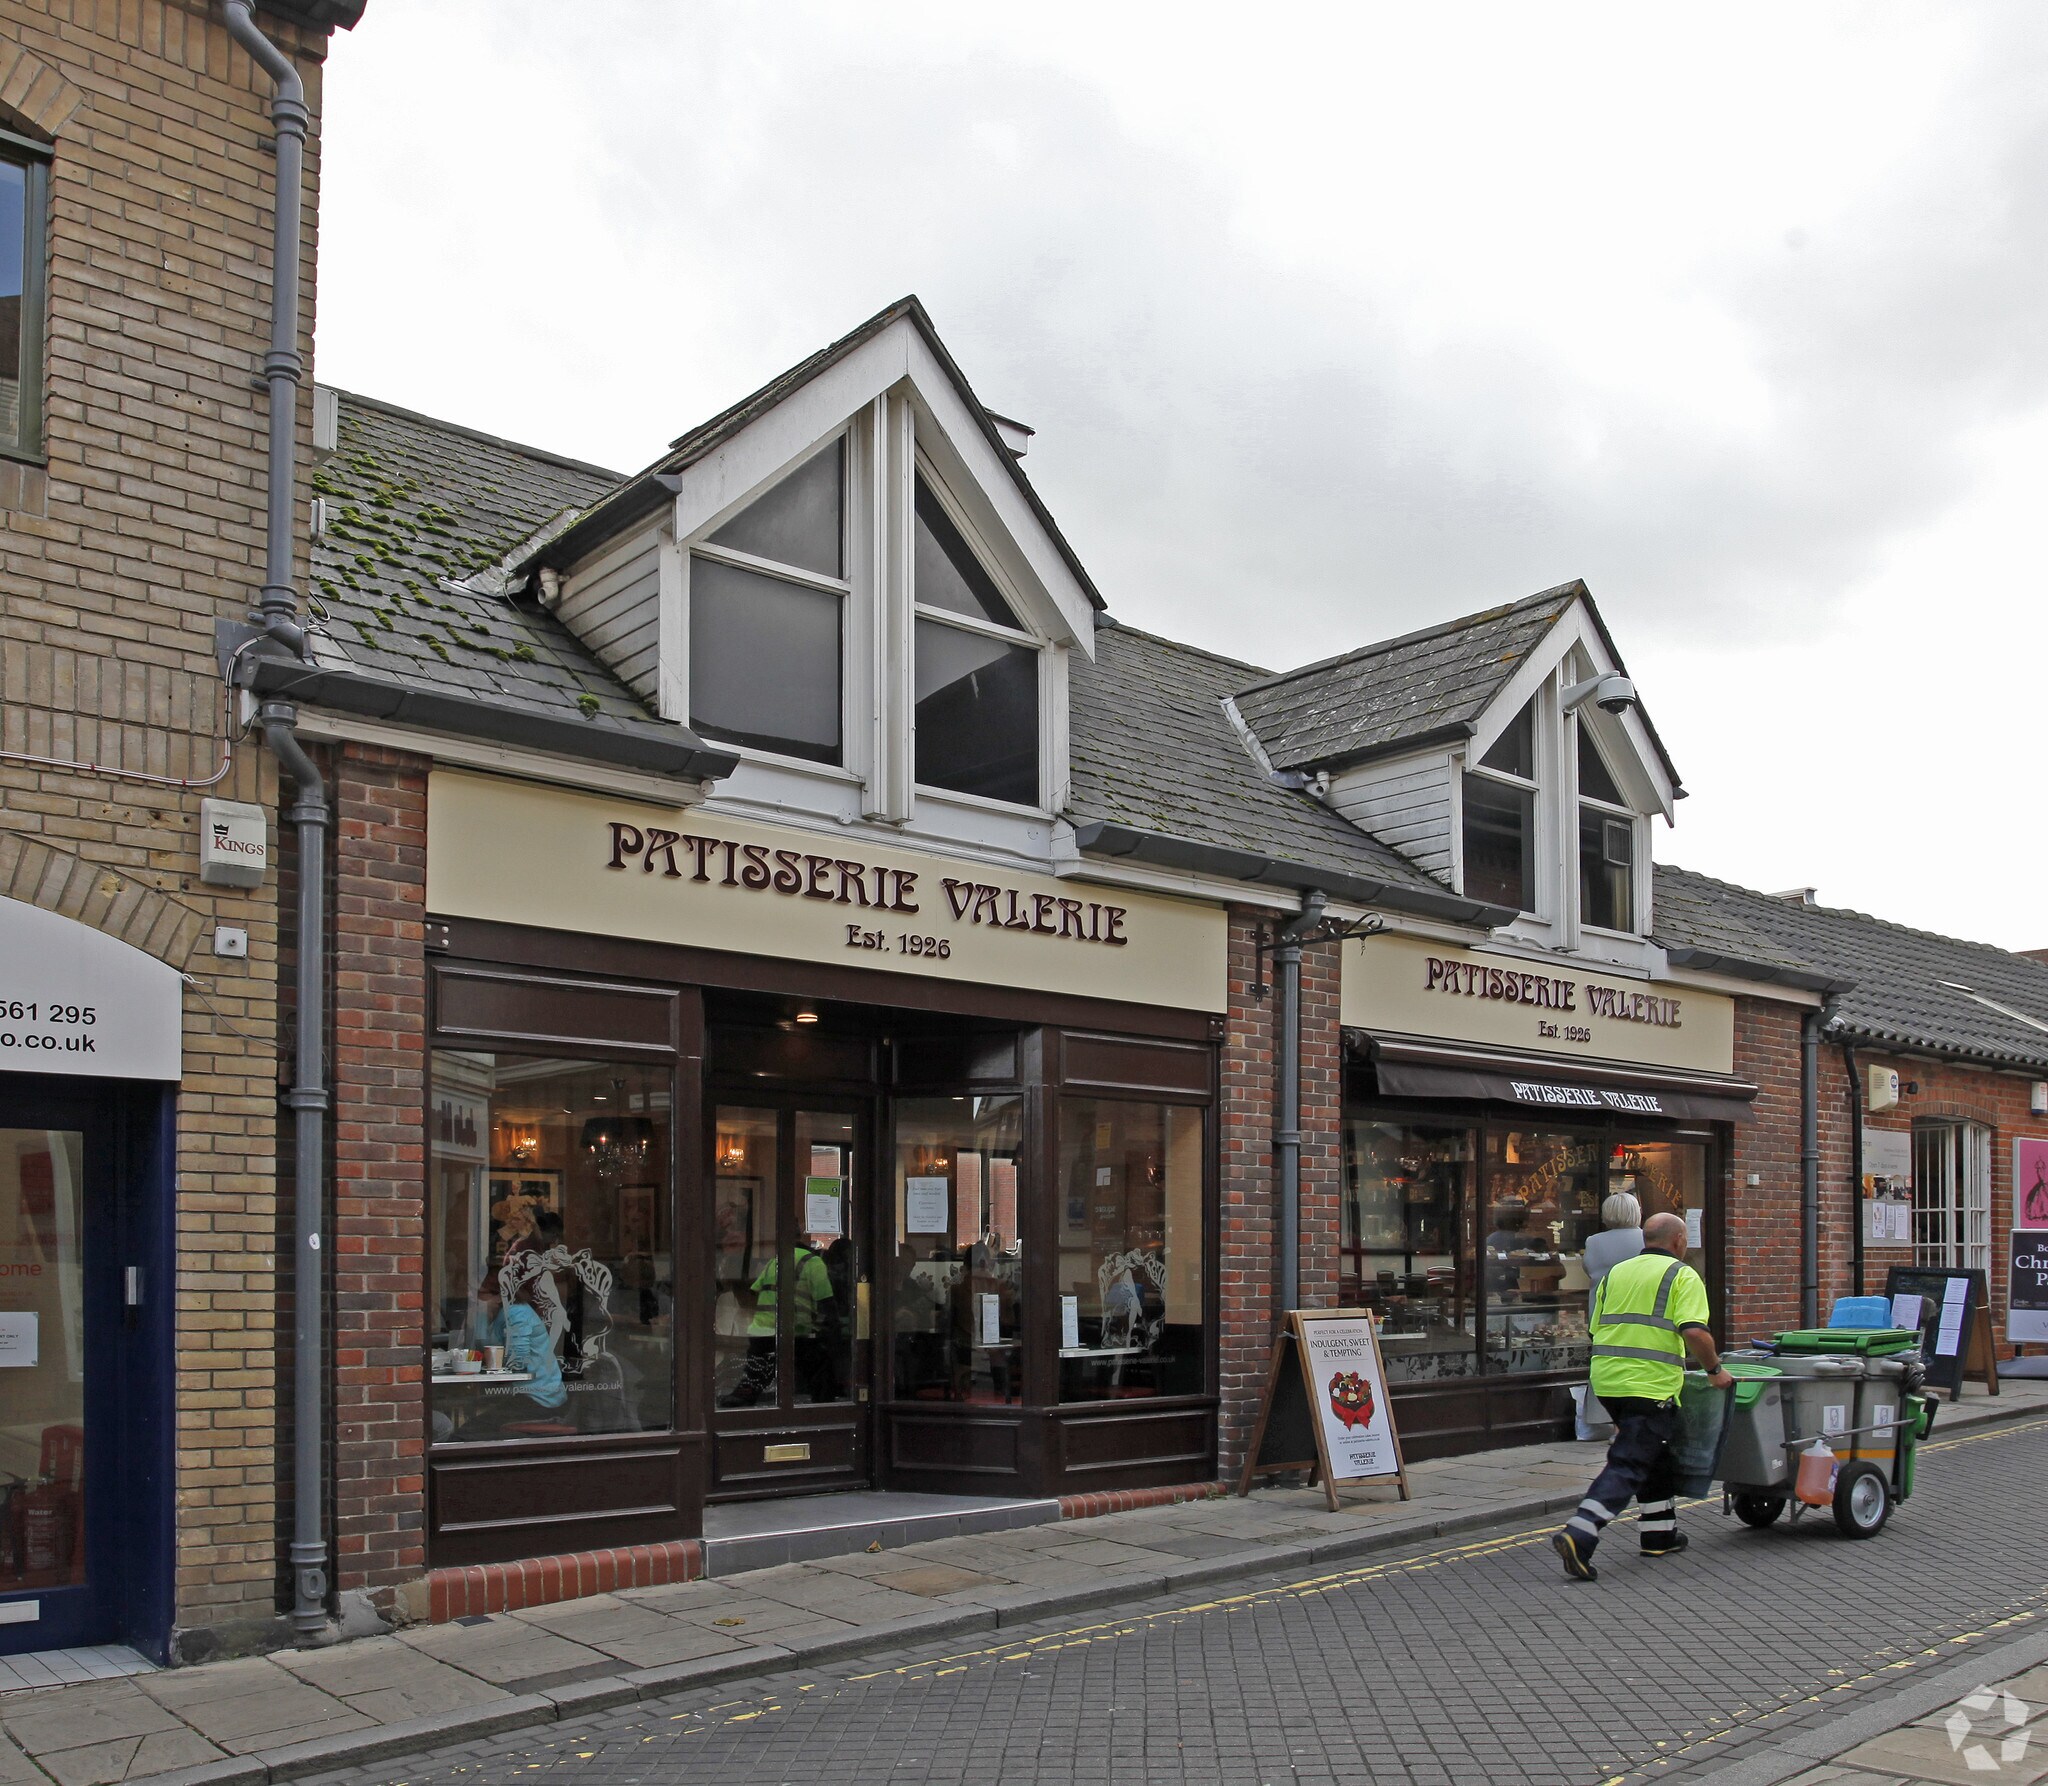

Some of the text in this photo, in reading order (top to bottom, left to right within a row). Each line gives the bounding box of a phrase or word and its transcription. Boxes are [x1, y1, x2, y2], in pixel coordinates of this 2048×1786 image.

[214, 835, 264, 855] KINGS
[607, 822, 1128, 946] PATISSERIE VALERIE
[846, 924, 951, 959] Est. 1926
[1424, 957, 1682, 1028] PATISSERIE VALERIE
[49, 1005, 96, 1025] 295
[1538, 1021, 1591, 1043] Est. 1926
[1510, 1081, 1662, 1112] PATISSERIE VALERIE
[1310, 1338, 1370, 1348] INDULGENT, SWEET
[1324, 1349, 1362, 1358] & TEMPTING
